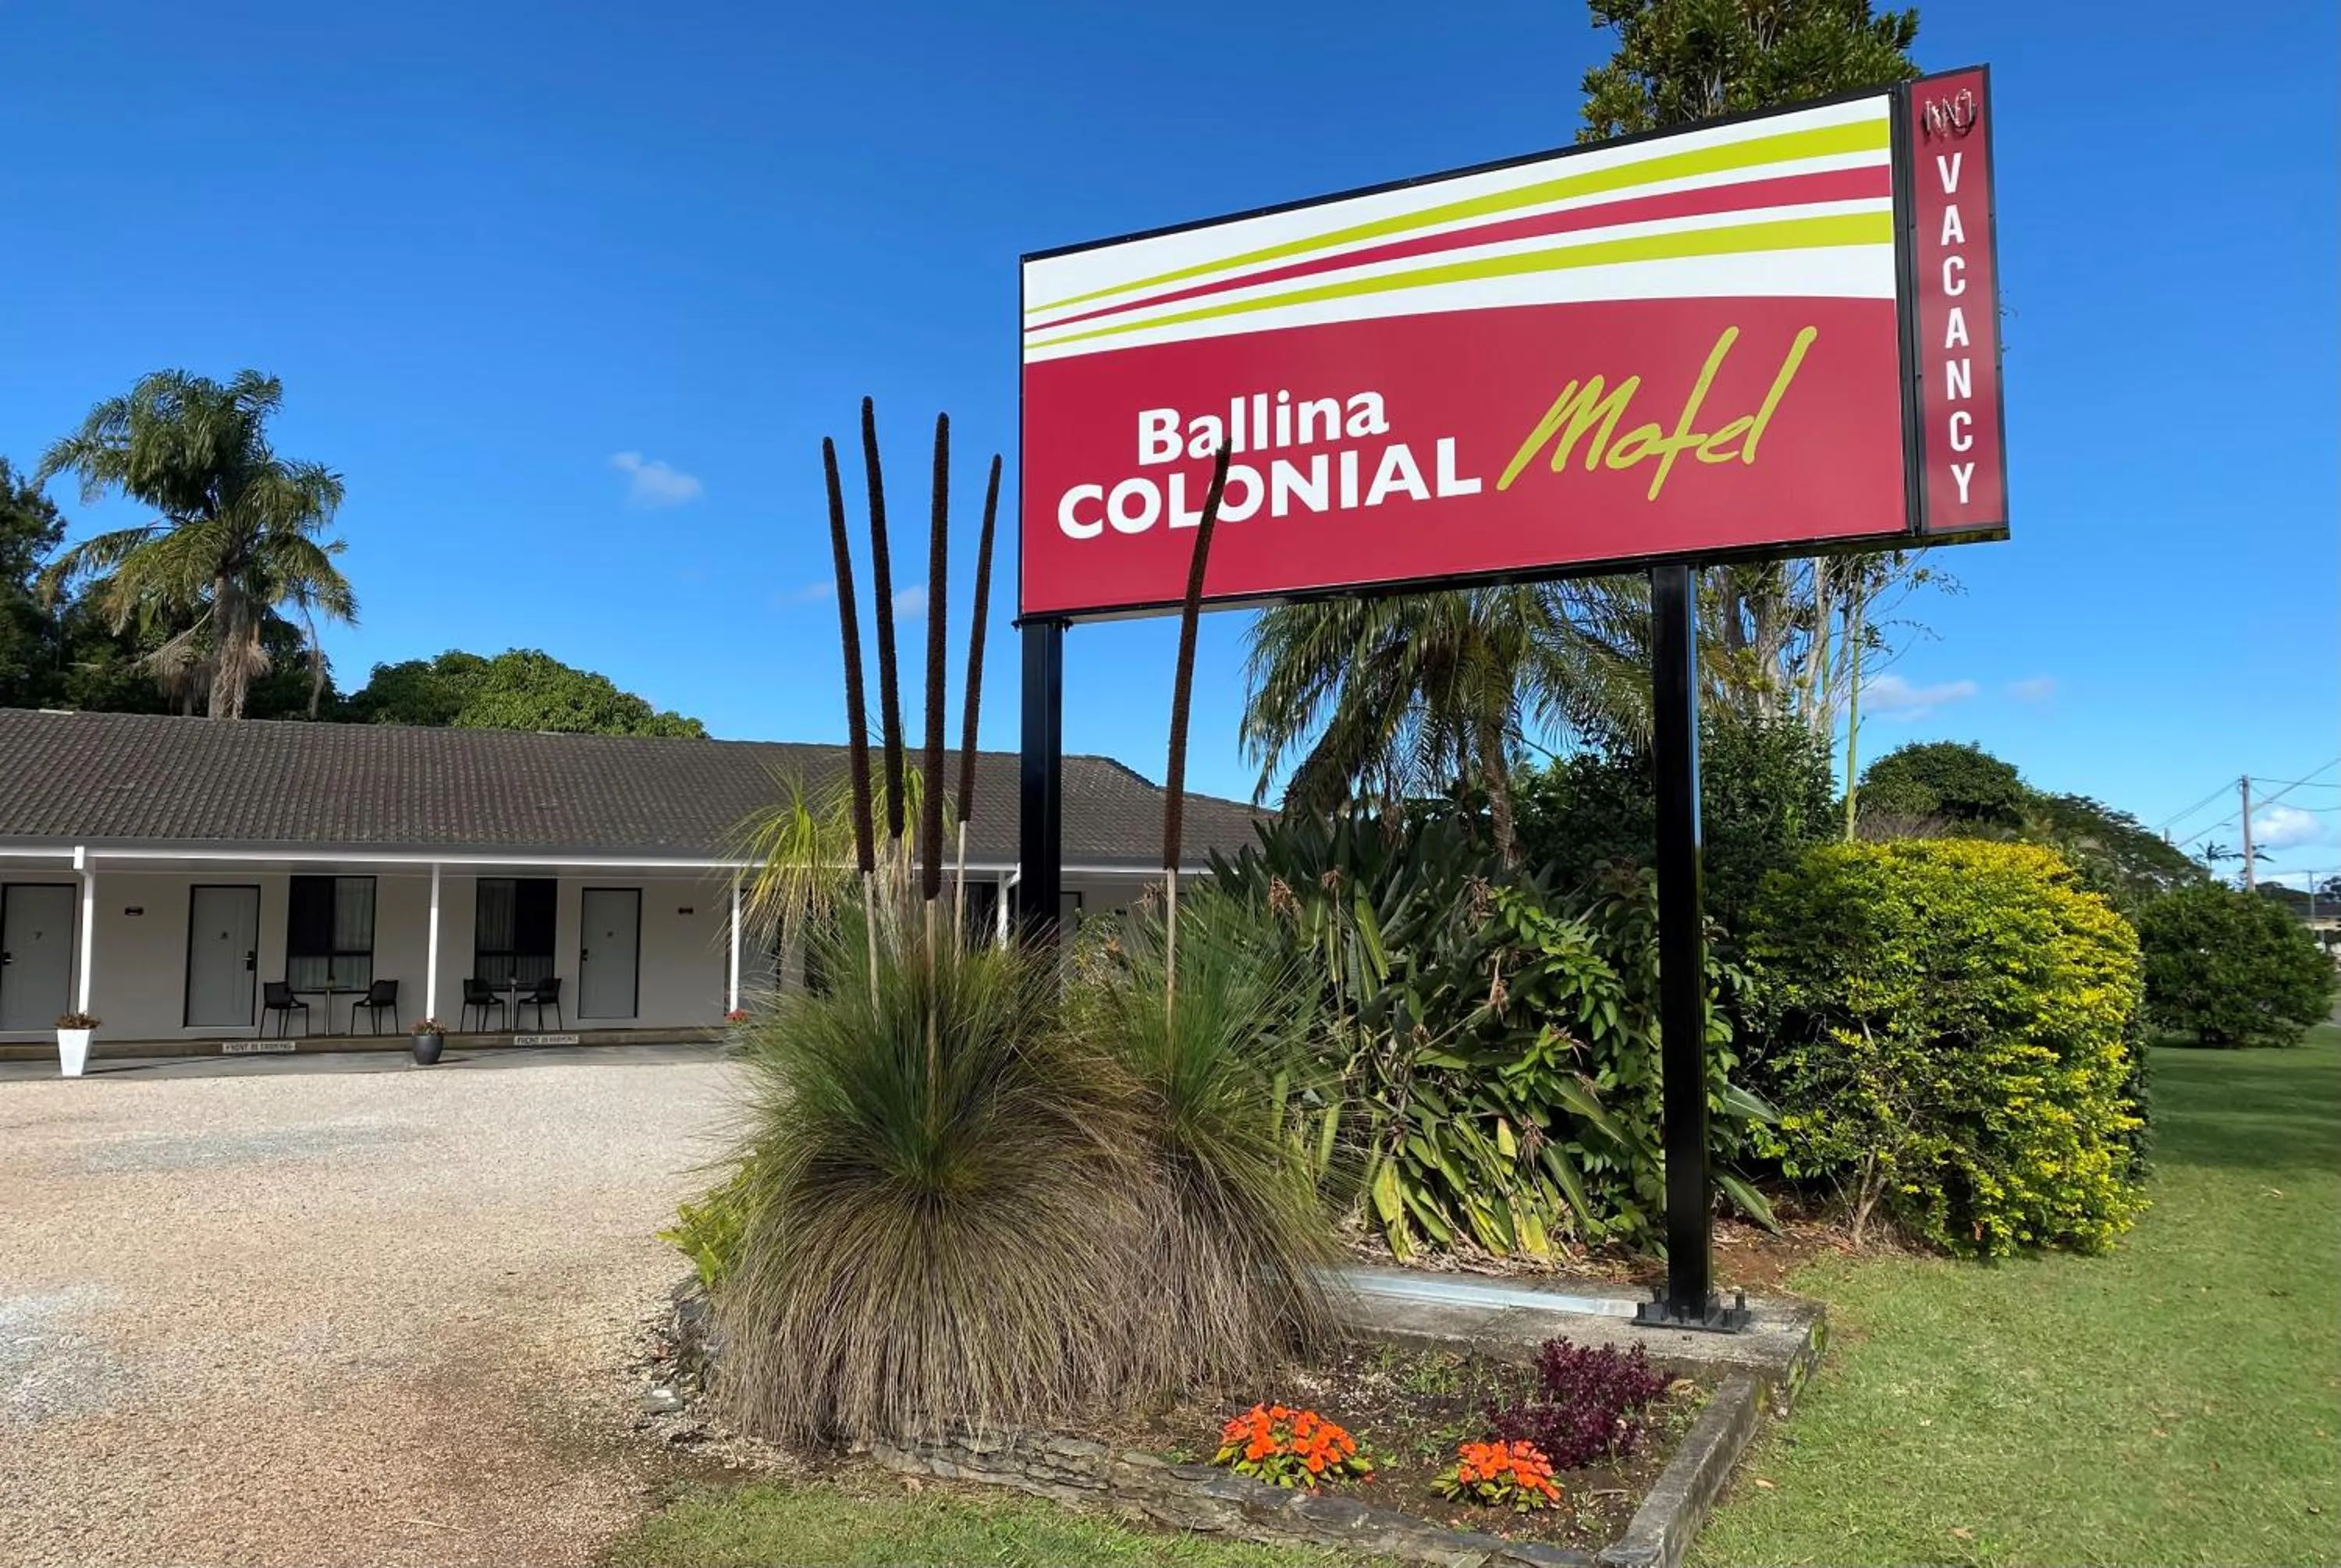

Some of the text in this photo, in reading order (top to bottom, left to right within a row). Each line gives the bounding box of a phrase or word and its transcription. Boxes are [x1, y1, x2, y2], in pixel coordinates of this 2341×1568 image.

[1924, 88, 1974, 137] NO
[1937, 152, 1975, 503] VACANCY
[1058, 325, 1817, 539] COLONIAL Motel
[1139, 389, 1390, 466] Ballina
